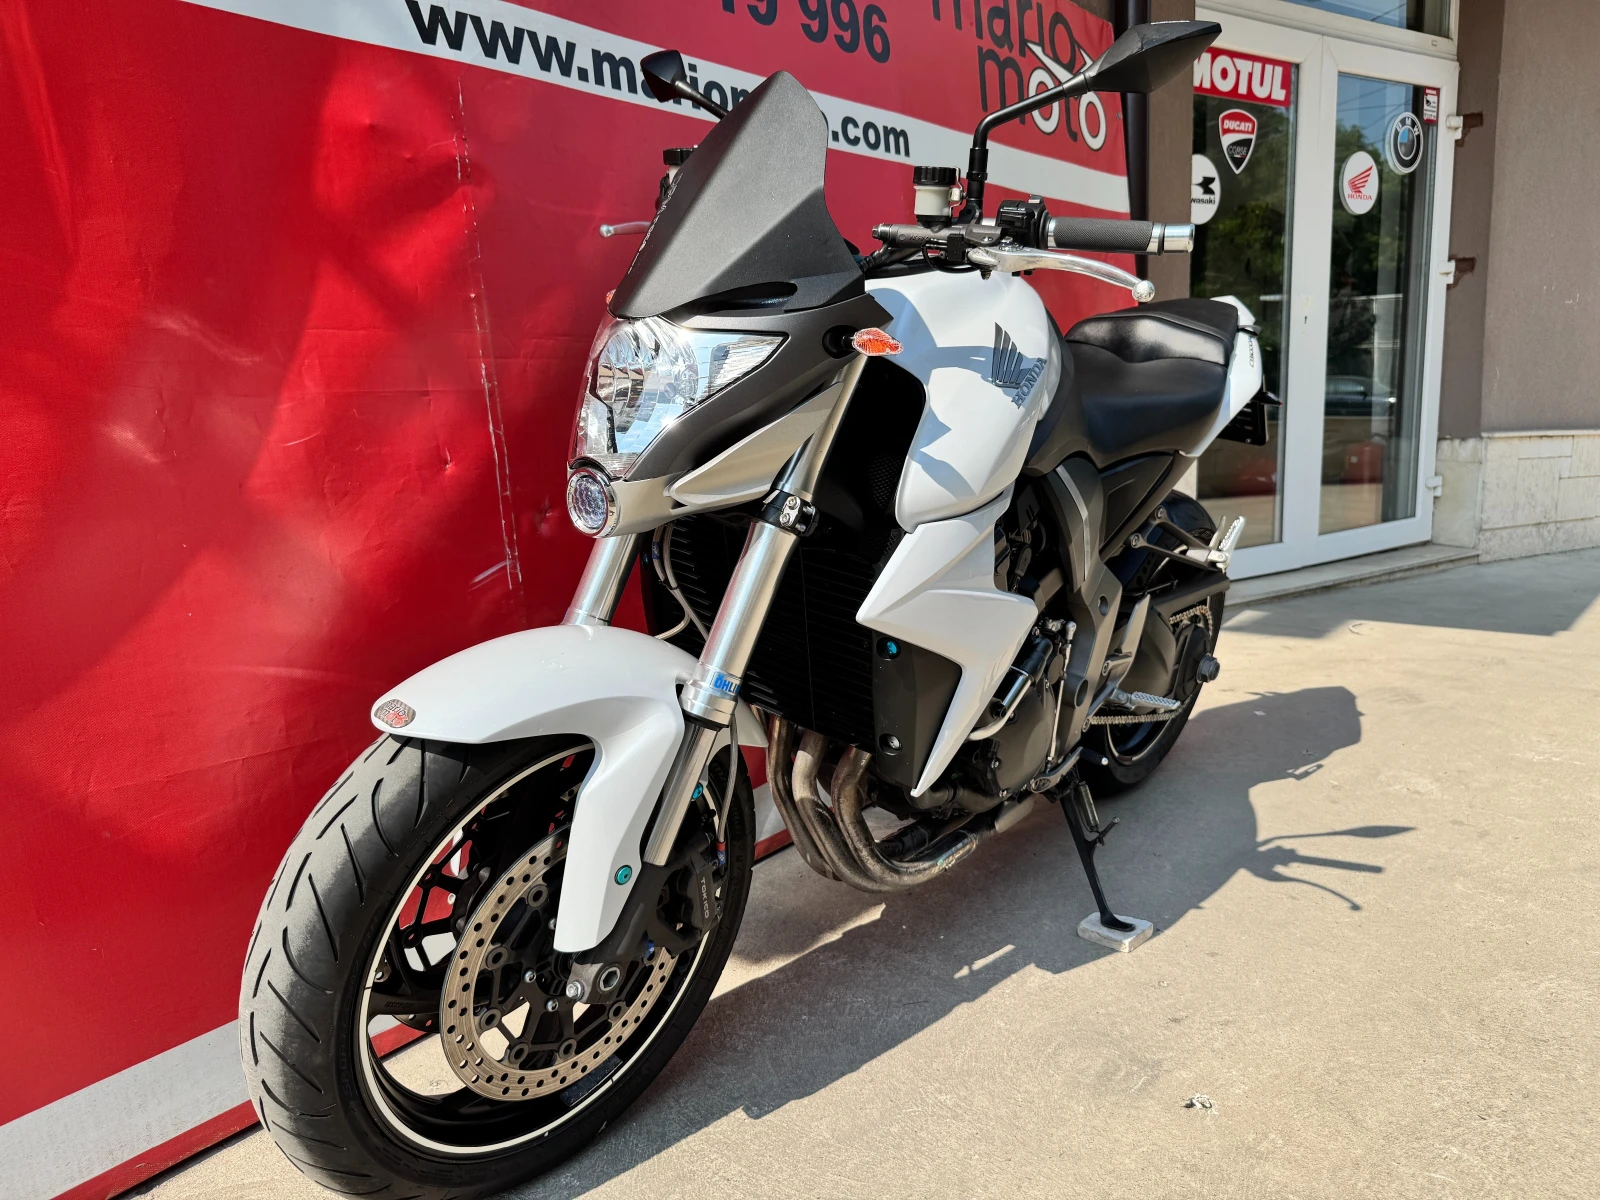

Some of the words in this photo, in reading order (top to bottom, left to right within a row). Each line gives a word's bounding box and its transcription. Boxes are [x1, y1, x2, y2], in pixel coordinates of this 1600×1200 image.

[798, 0, 891, 64] 996
[1192, 52, 1286, 102] MOTUL
[1223, 119, 1253, 132] DUCATI
[1396, 117, 1420, 136] BMW
[1191, 196, 1216, 205] wasaki
[1347, 193, 1373, 201] HONDA
[1011, 357, 1047, 410] HONDA
[700, 876, 710, 919] TOKICO
